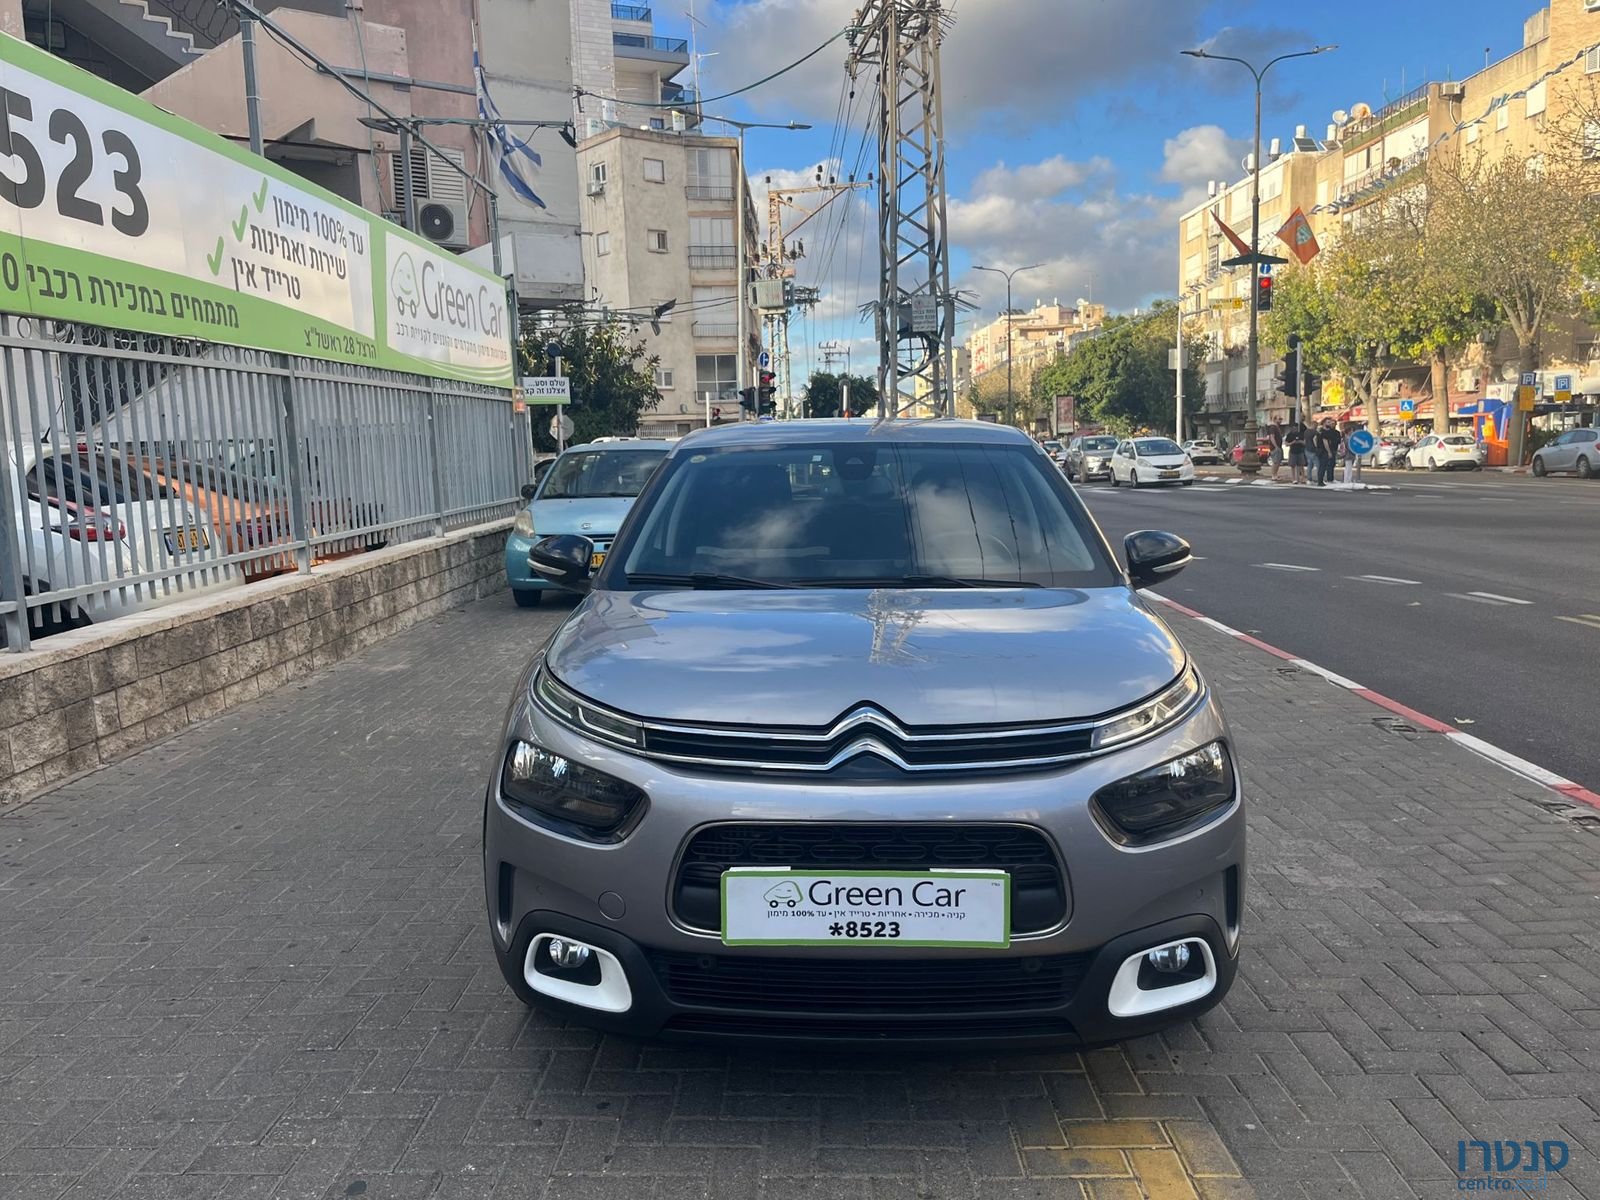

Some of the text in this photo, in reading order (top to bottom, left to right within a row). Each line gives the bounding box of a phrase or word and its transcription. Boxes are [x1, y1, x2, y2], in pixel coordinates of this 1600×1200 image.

[272, 195, 364, 256] עד 100% מימון
[250, 224, 346, 280] שירות ואמינות
[231, 256, 301, 301] טרייד אין
[2, 252, 240, 328] מתמחים במכירת רכבי 0
[421, 260, 502, 340] Green Car
[396, 322, 409, 337] רכב
[343, 335, 355, 355] 28
[355, 337, 377, 360] הרצל
[550, 379, 566, 387] שלם
[537, 387, 545, 395] זה
[547, 387, 566, 395] אצלנו
[808, 880, 966, 908] Green Car
[767, 910, 789, 918] מימון
[834, 910, 847, 919] אין
[849, 910, 871, 918] טרייד
[877, 910, 907, 918] אחריות
[946, 912, 966, 920] קניה
